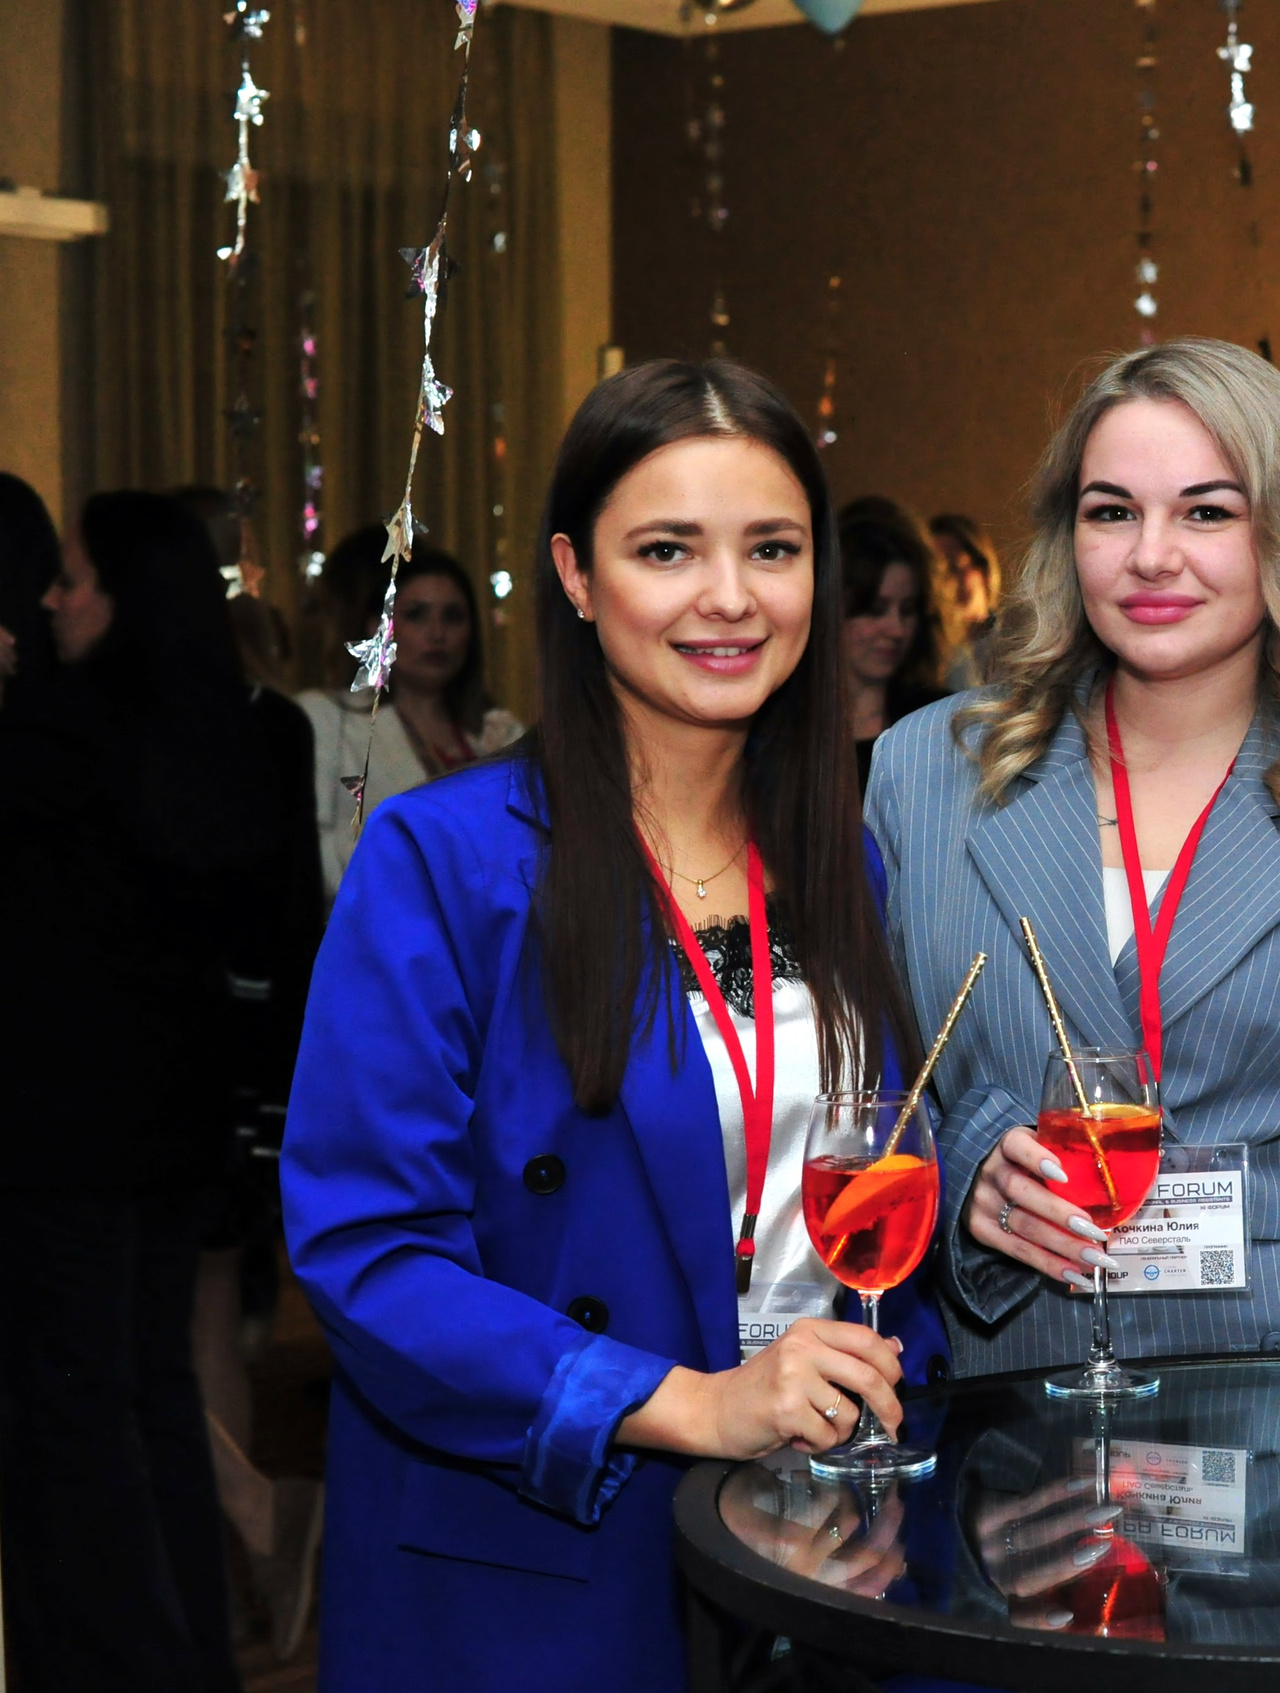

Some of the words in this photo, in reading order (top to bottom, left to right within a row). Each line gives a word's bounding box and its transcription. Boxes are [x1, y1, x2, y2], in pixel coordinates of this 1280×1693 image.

[1157, 1181, 1233, 1197] FORUM
[1113, 1224, 1164, 1234] Кочкина
[1166, 1221, 1200, 1232] Юлия
[1119, 1237, 1139, 1245] ПАО
[1141, 1235, 1192, 1246] Северсталь
[738, 1323, 792, 1338] FORU
